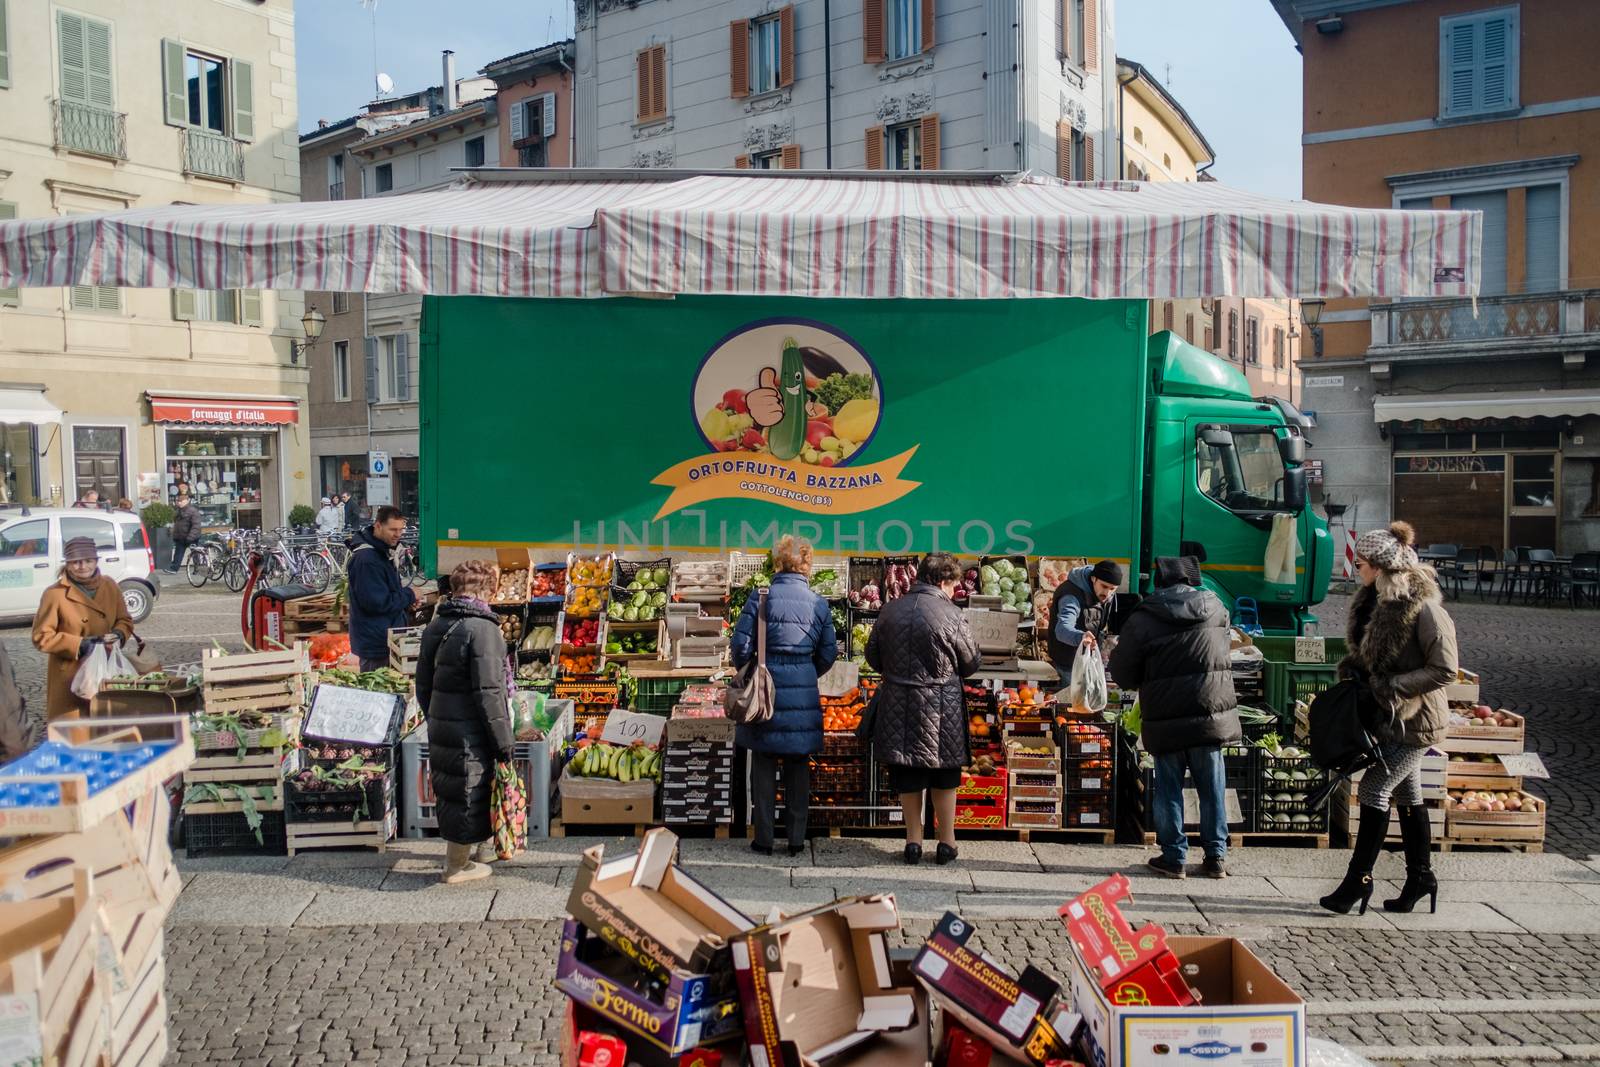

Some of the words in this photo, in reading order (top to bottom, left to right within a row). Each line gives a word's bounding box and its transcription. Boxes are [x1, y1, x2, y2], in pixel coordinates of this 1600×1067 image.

[191, 409, 232, 421] formaggi
[236, 410, 265, 421] d'italia
[688, 460, 797, 483] ORTOFRUTTA
[806, 472, 883, 490] BAZZANA
[740, 481, 810, 503] GOTTOLENGO
[811, 495, 833, 507] (BS)
[954, 946, 974, 966] Fior
[975, 961, 1019, 997] d'arancia
[592, 978, 661, 1034] Fermo
[1190, 1046, 1231, 1054] GRASSO
